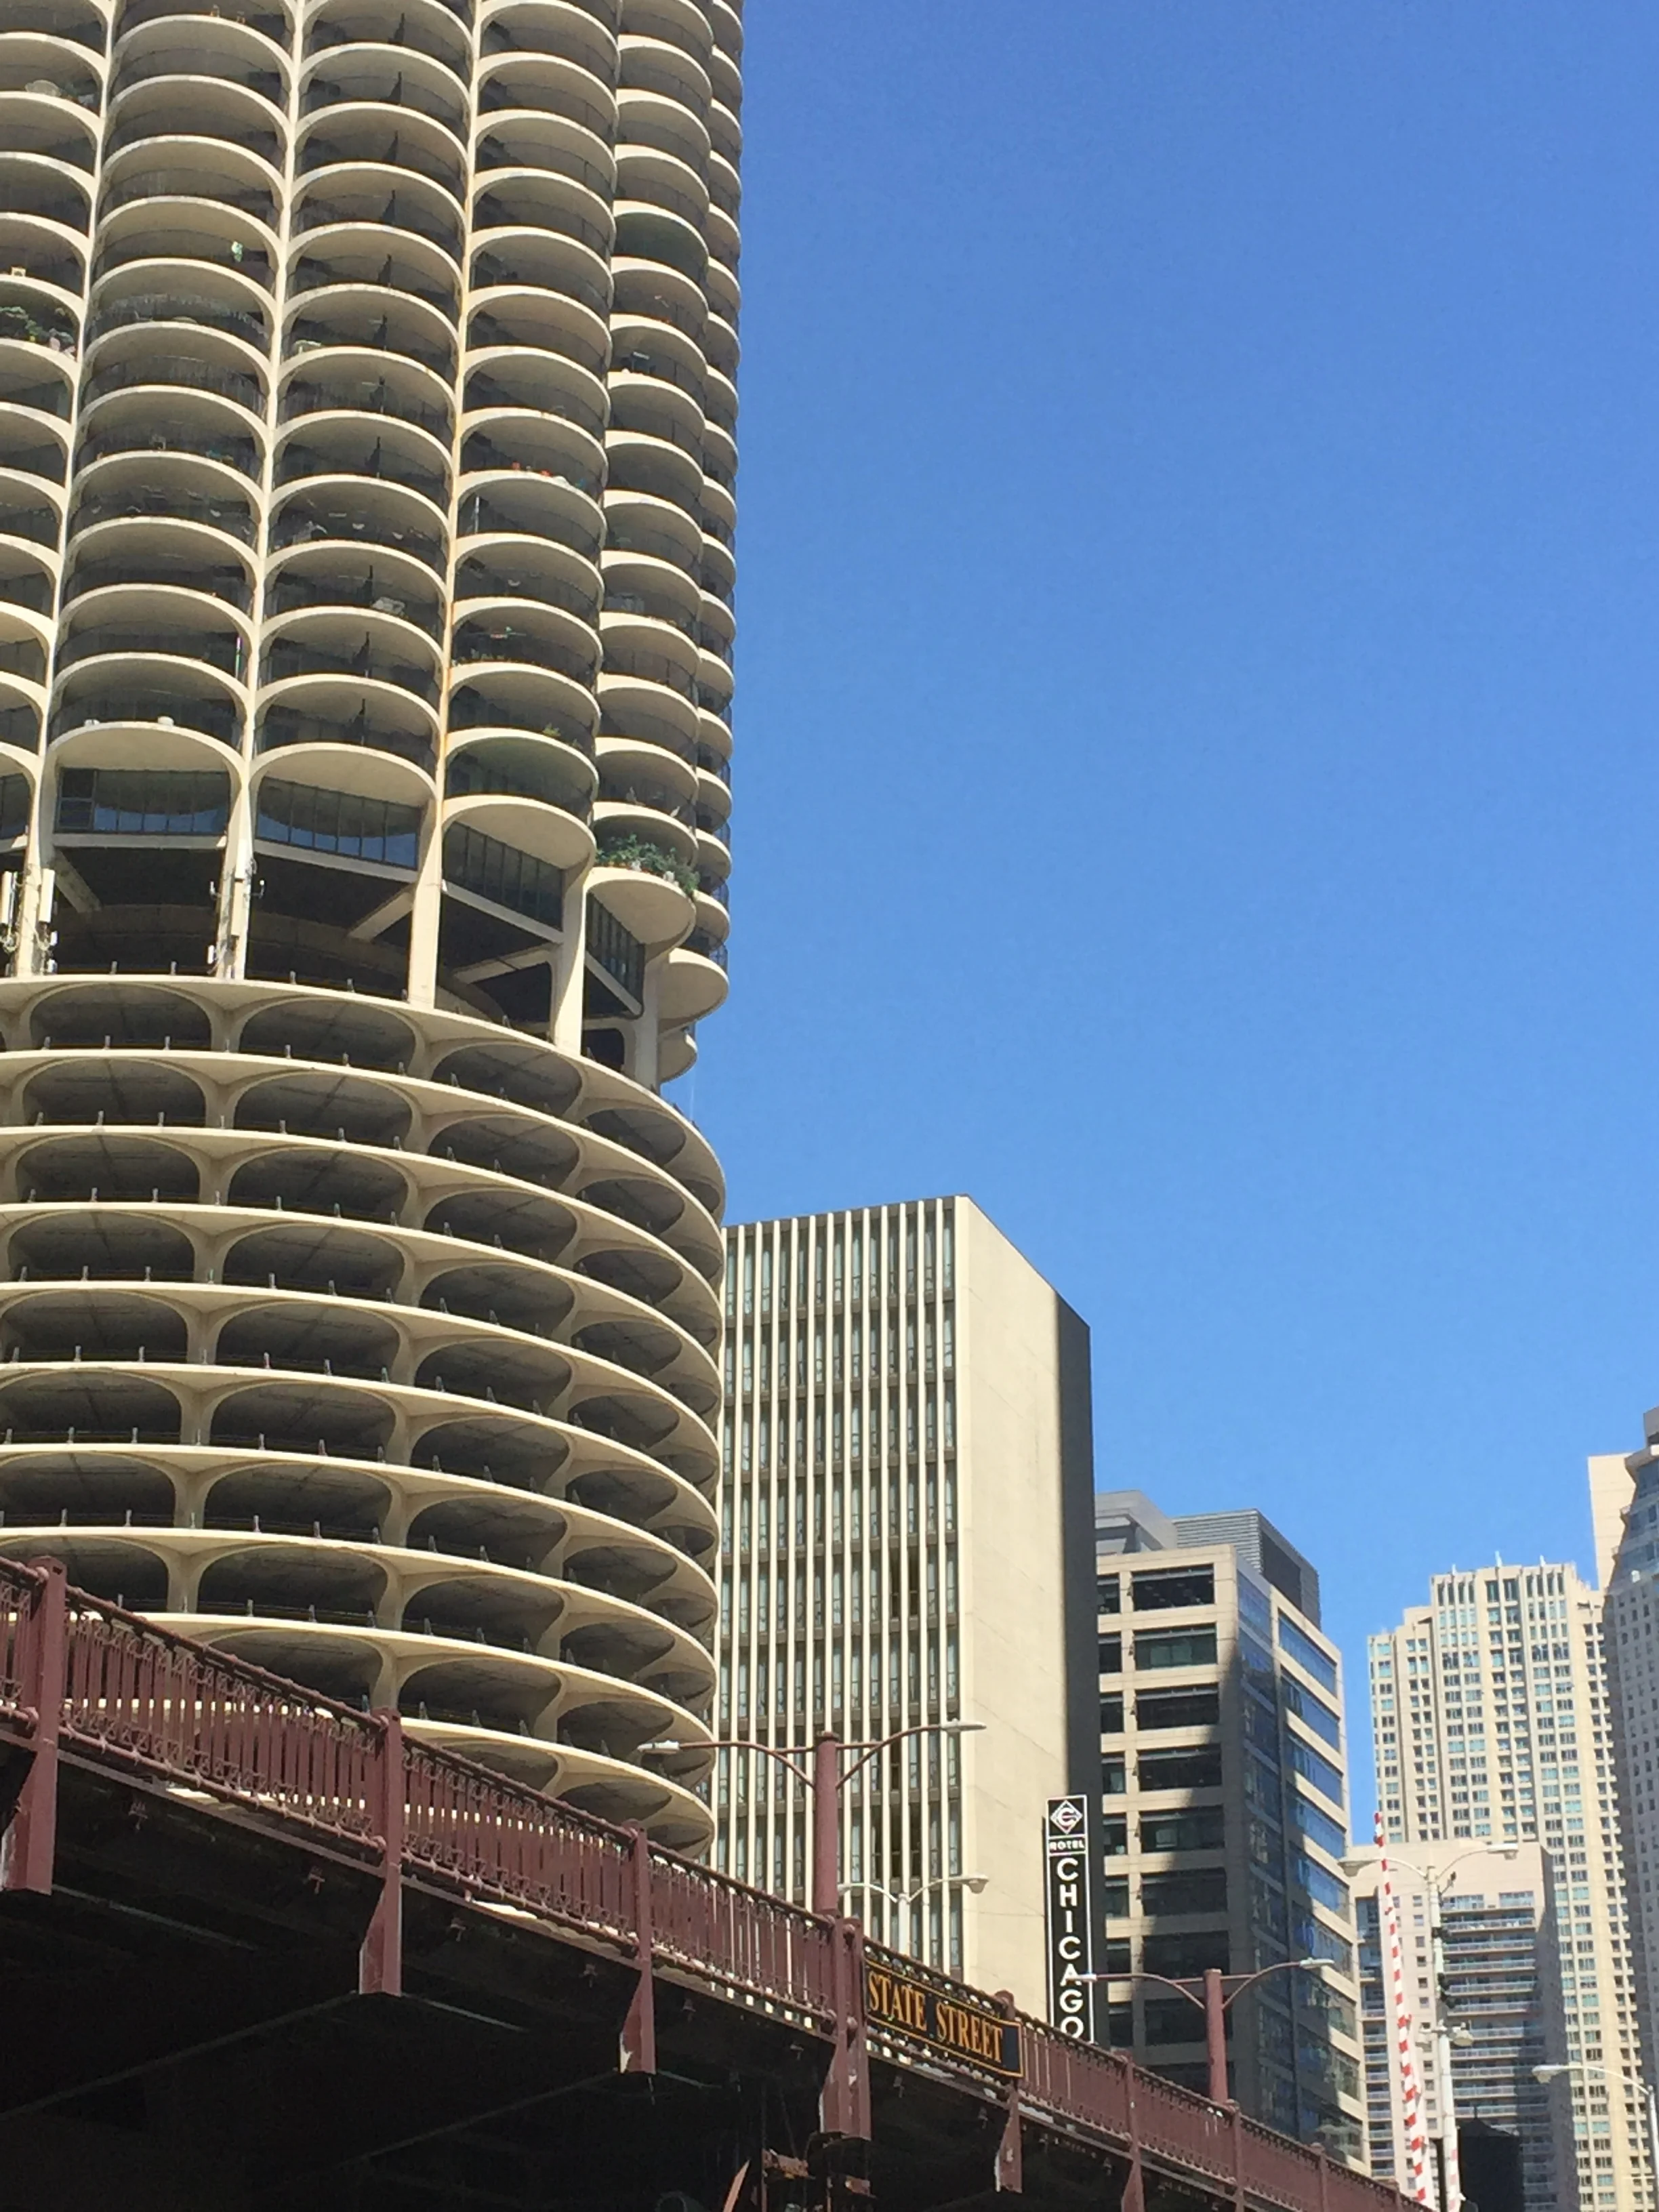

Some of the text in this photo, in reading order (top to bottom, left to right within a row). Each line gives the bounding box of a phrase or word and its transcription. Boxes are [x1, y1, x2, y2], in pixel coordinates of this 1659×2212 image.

[1049, 1840, 1084, 1851] HOTEL
[1057, 1858, 1084, 2039] CHICAGO
[868, 1970, 1003, 2063] STATE STREET
